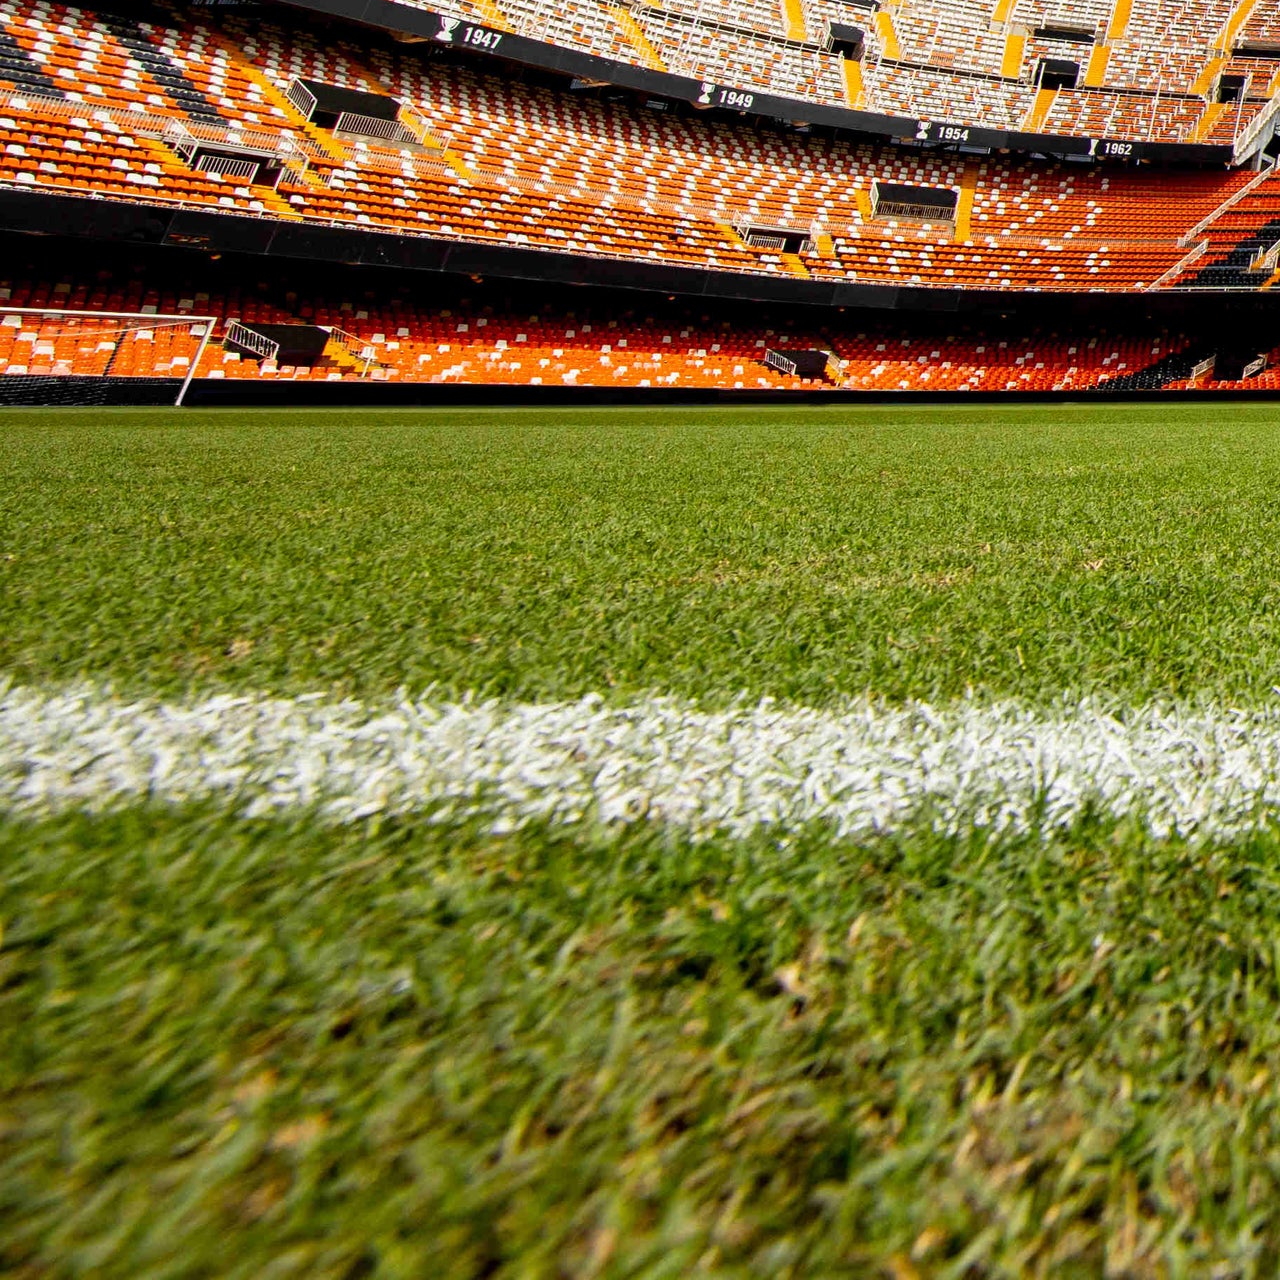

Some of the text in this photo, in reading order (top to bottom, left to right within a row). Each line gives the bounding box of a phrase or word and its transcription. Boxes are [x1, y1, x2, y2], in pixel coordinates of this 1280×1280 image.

[463, 27, 503, 49] 1947
[719, 90, 754, 108] 1949
[938, 126, 969, 141] 1954
[1104, 143, 1132, 156] 1962
